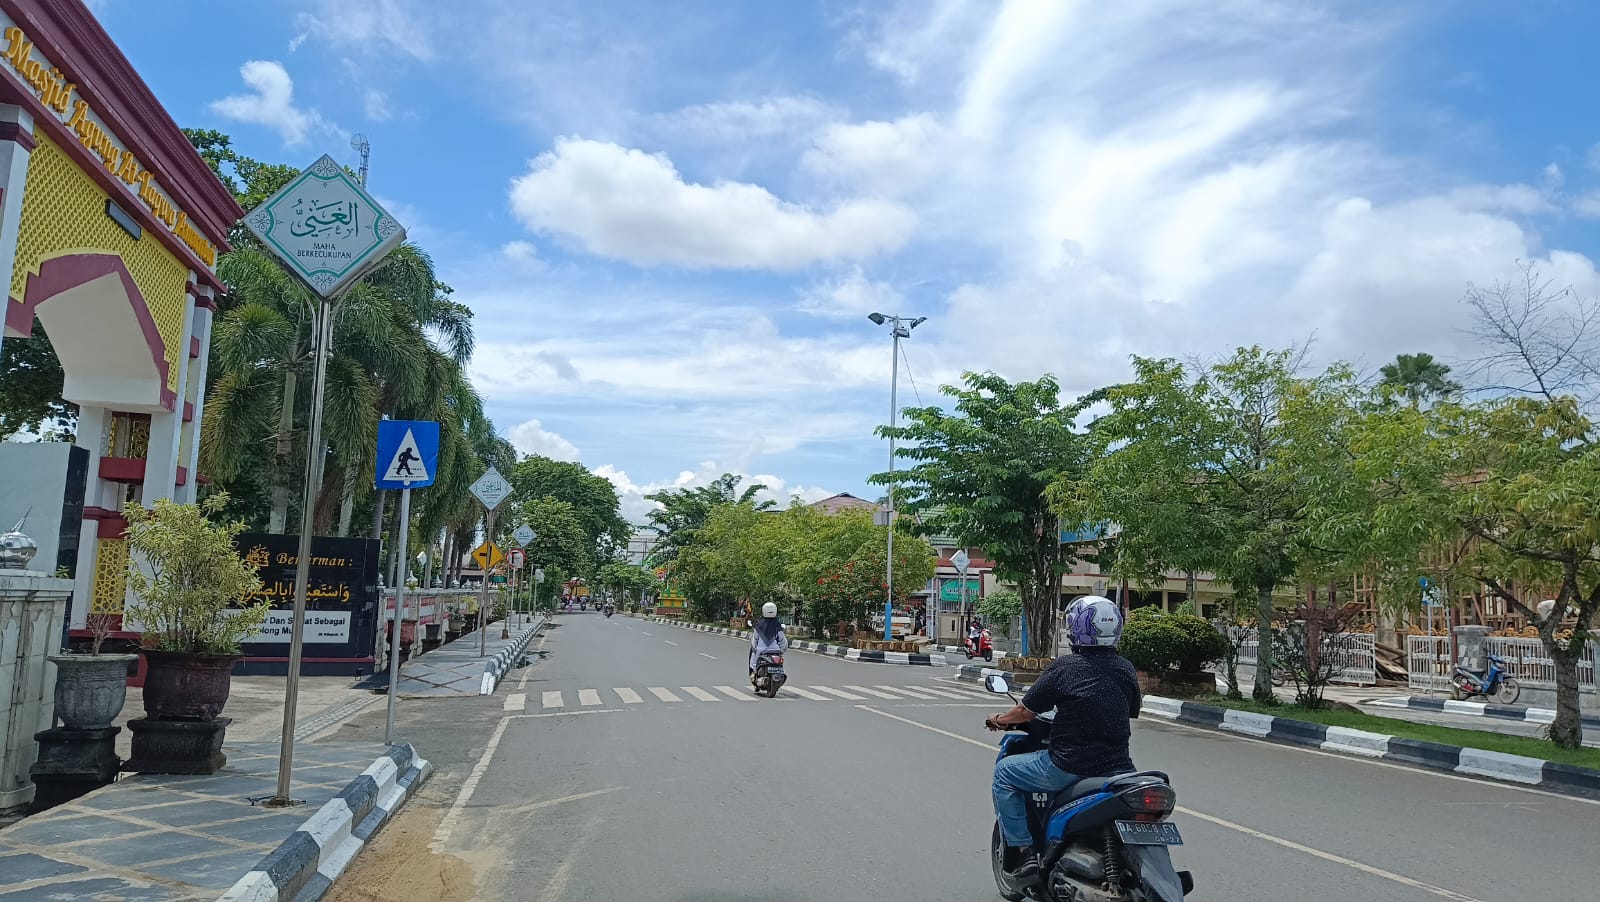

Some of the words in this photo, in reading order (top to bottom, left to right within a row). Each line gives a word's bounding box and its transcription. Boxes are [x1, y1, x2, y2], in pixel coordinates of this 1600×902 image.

[2, 27, 76, 113] Masjid
[65, 101, 119, 174] Agung
[313, 242, 336, 251] MAHA
[297, 249, 352, 259] BERKECUKUPAN
[269, 617, 286, 625] Dan
[314, 617, 345, 627] Sebagai
[1118, 822, 1133, 833] DA
